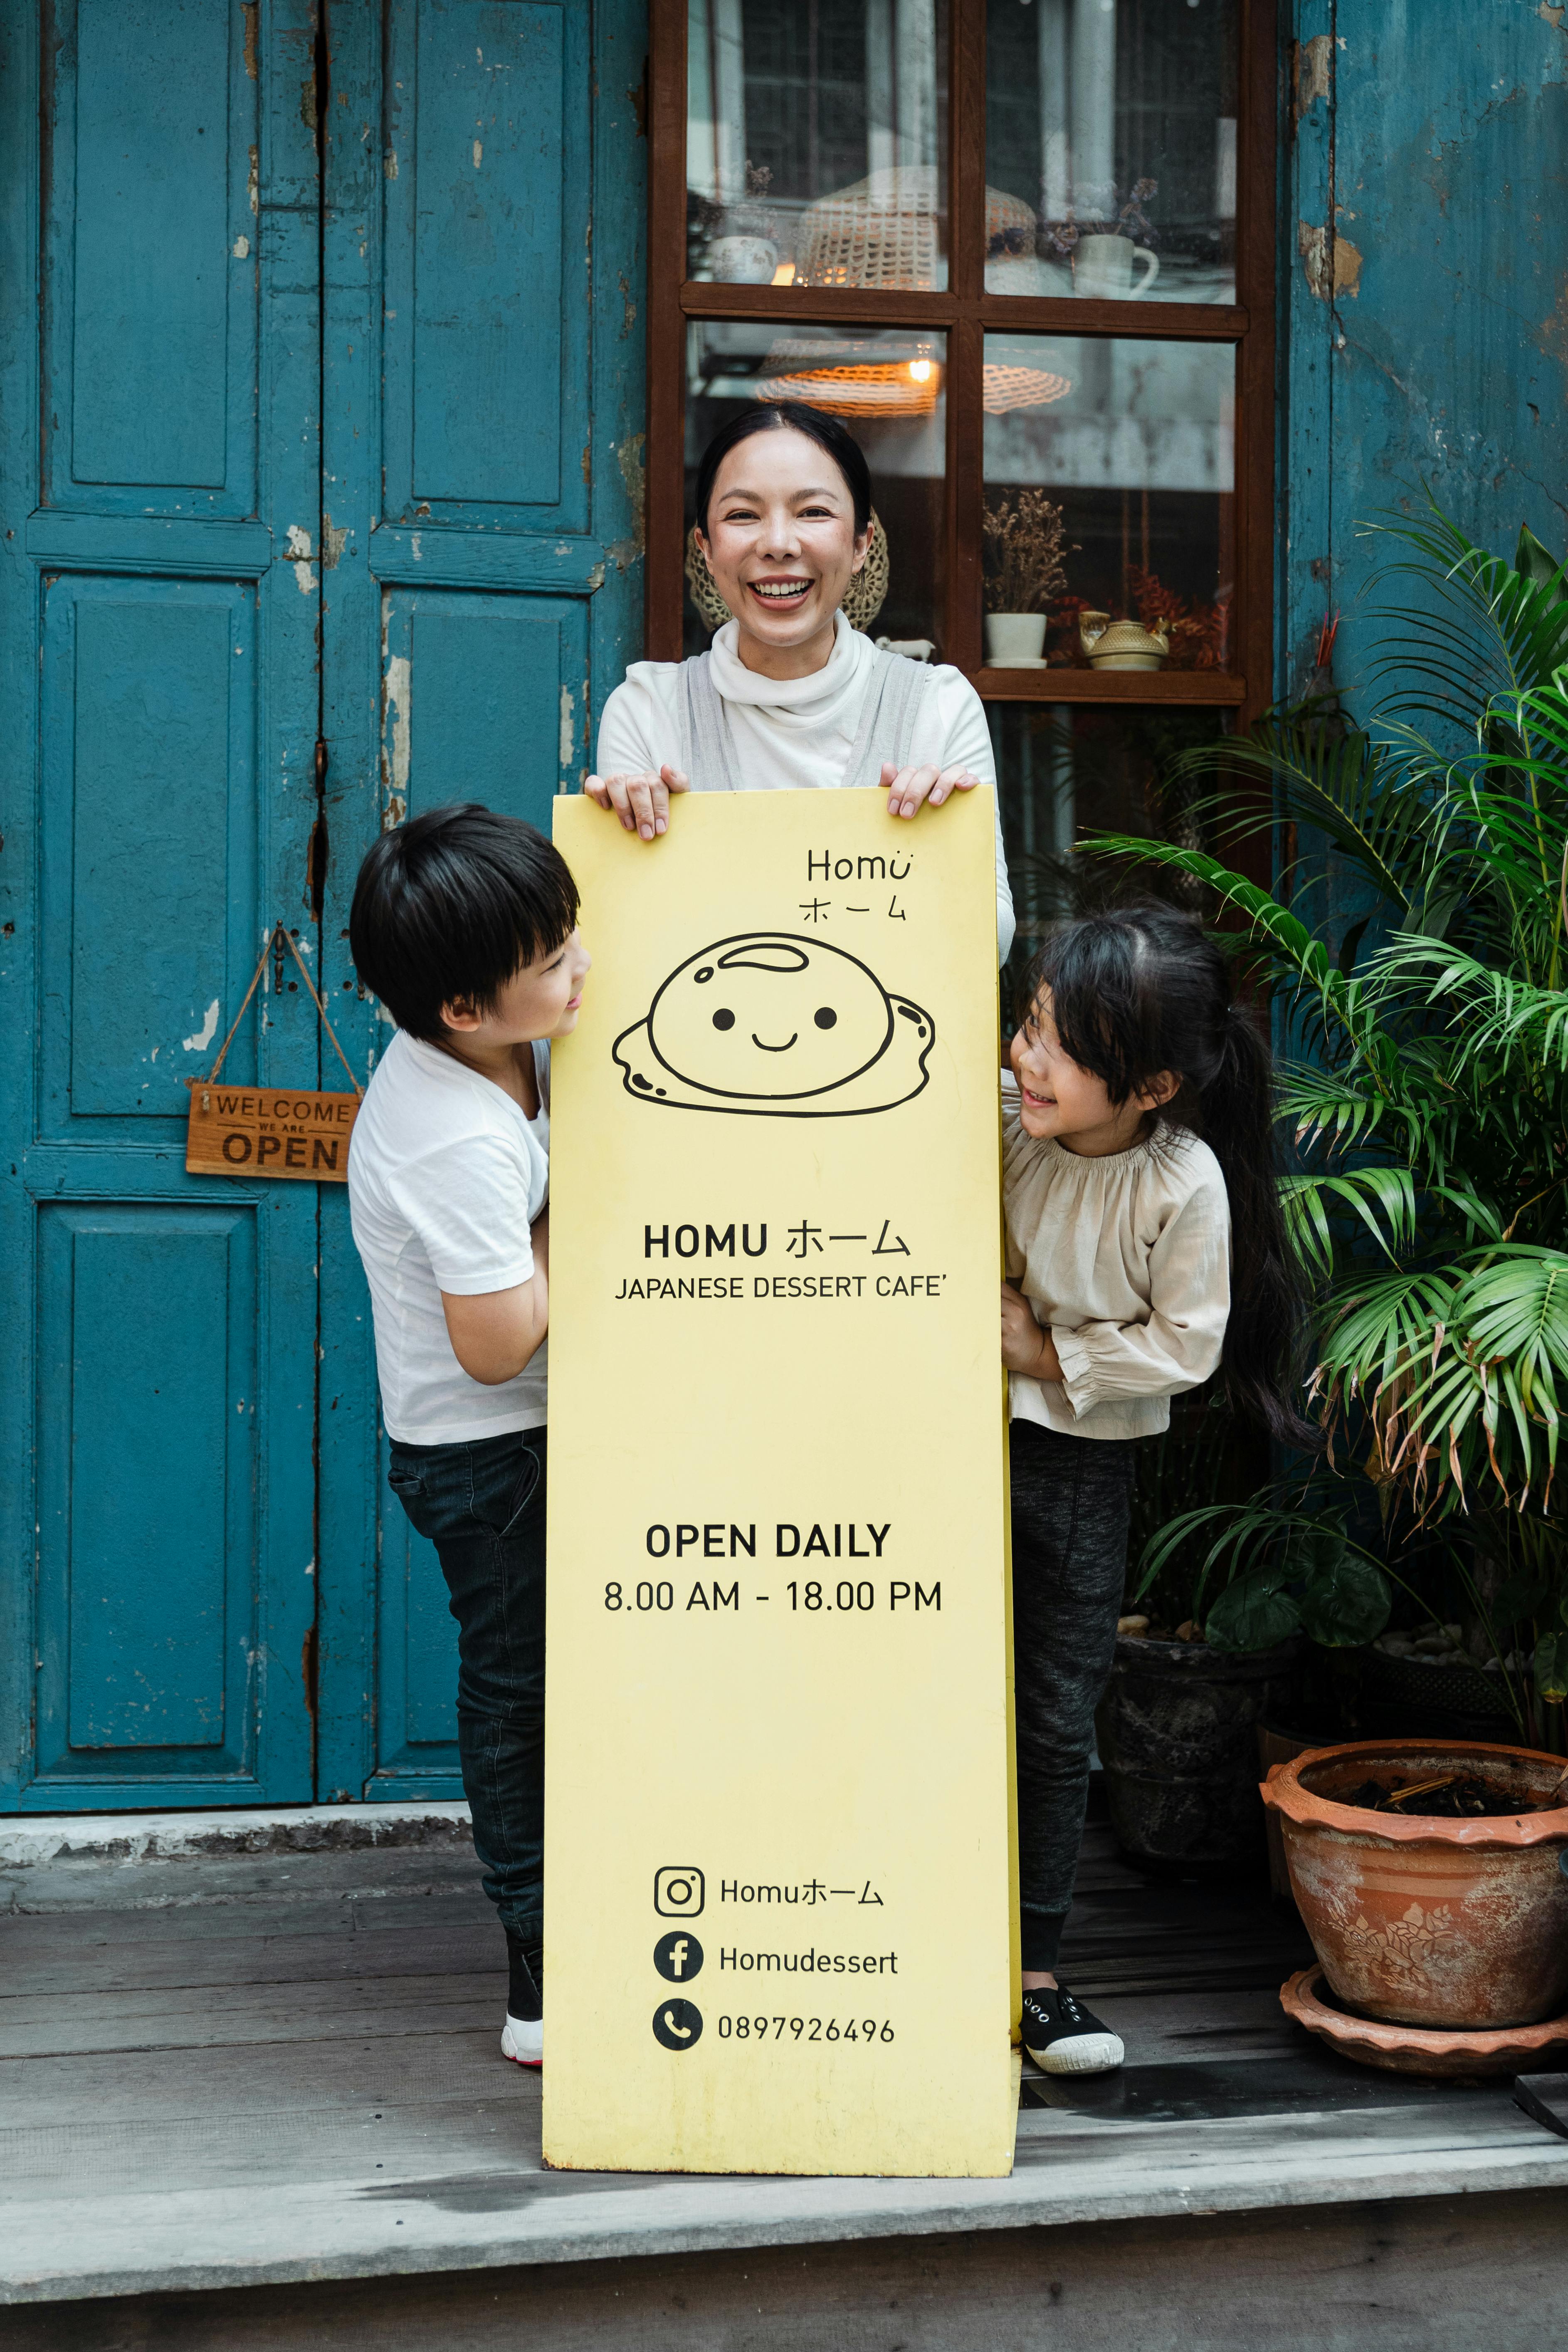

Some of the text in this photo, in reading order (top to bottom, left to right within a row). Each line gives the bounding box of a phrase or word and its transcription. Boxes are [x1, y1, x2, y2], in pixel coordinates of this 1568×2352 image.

[798, 895, 906, 923] ホーム
[217, 1095, 350, 1123] WELCOME
[259, 1123, 305, 1134] WE ARE
[222, 1133, 338, 1171] OPEN
[644, 1219, 911, 1259] HOMU ホーム
[615, 1277, 744, 1300] JAPANESE
[754, 1276, 867, 1298] DESSERT
[646, 1524, 891, 1558] OPEN DAILY
[604, 1581, 674, 1611] 8.00
[685, 1581, 739, 1611] AM
[787, 1581, 874, 1611] 18.00
[890, 1581, 941, 1611] PM
[720, 1947, 898, 1974] Homudessert
[718, 2015, 895, 2043] 0897926496
